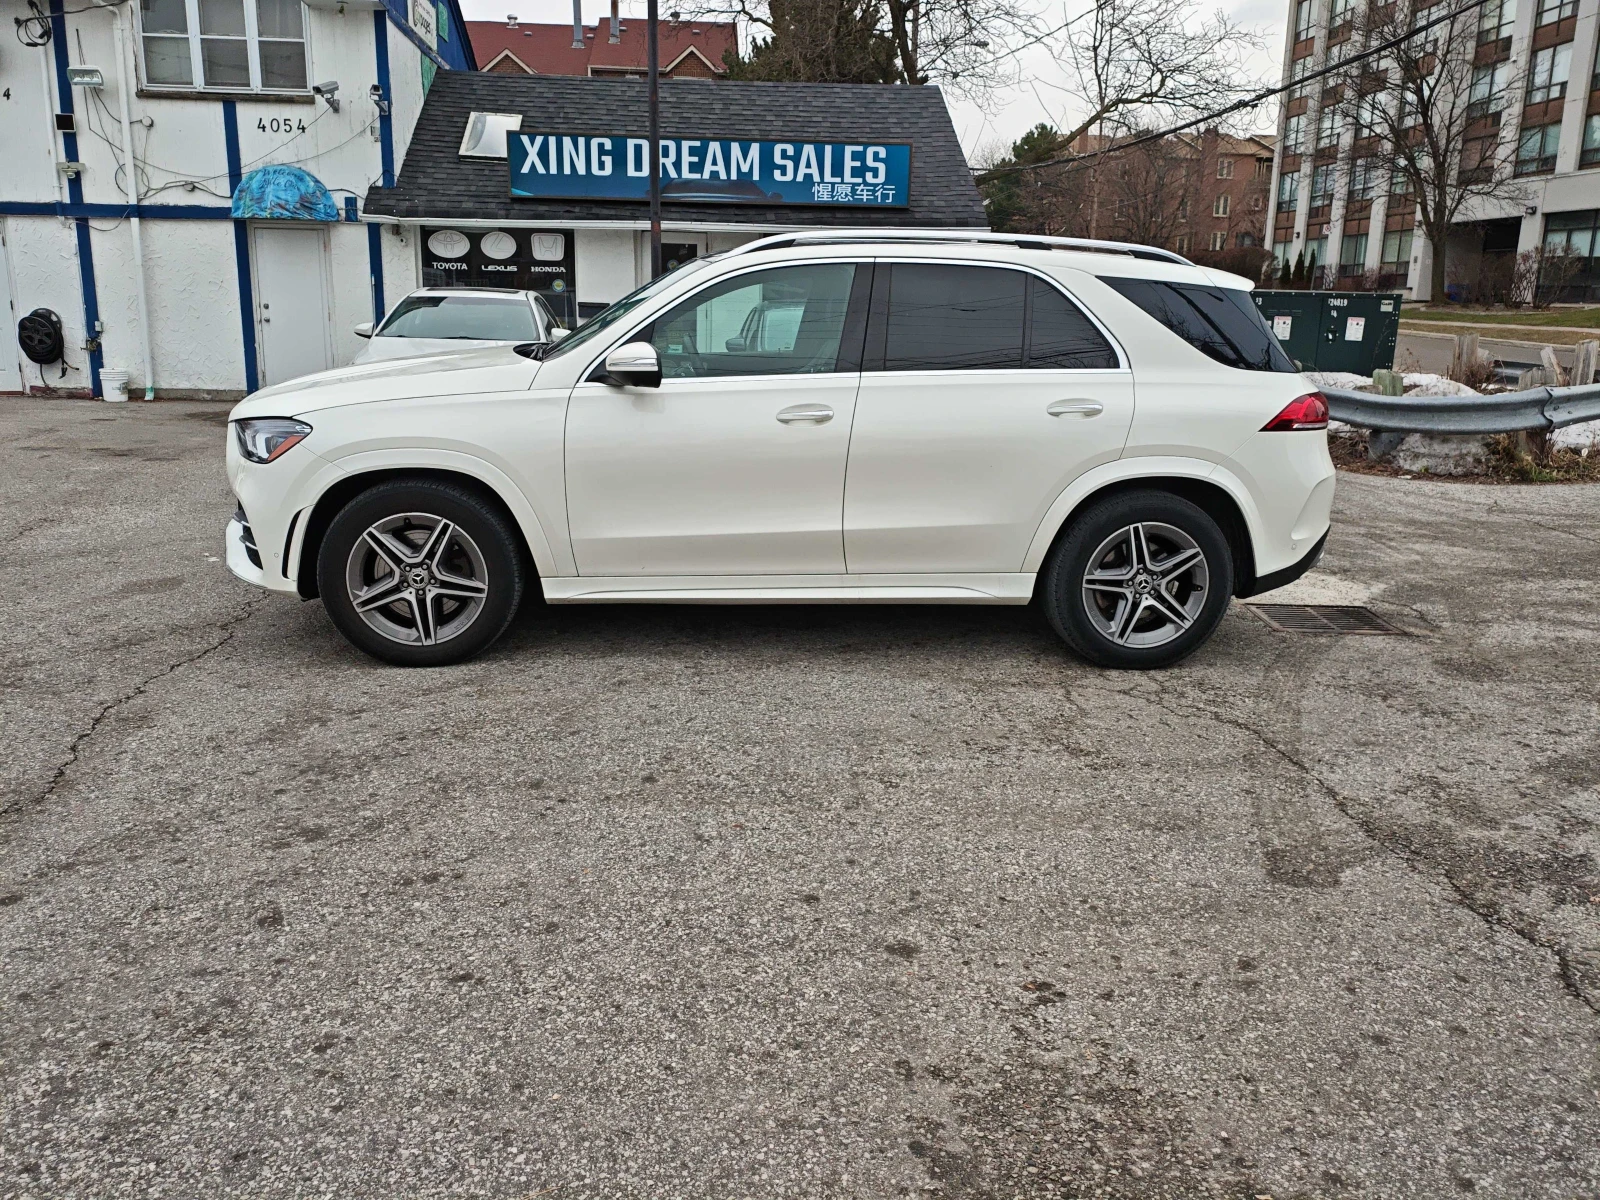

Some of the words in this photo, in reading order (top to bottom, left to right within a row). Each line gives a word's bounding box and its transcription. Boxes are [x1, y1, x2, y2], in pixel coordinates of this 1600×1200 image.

[2, 87, 12, 101] 4
[256, 117, 306, 134] 4054
[519, 134, 613, 177] XING
[626, 138, 760, 181] DREAM
[773, 143, 887, 184] SALES
[811, 182, 896, 203] 惺愿车行
[432, 261, 469, 271] TOYOTA
[481, 264, 518, 272] LEXUS
